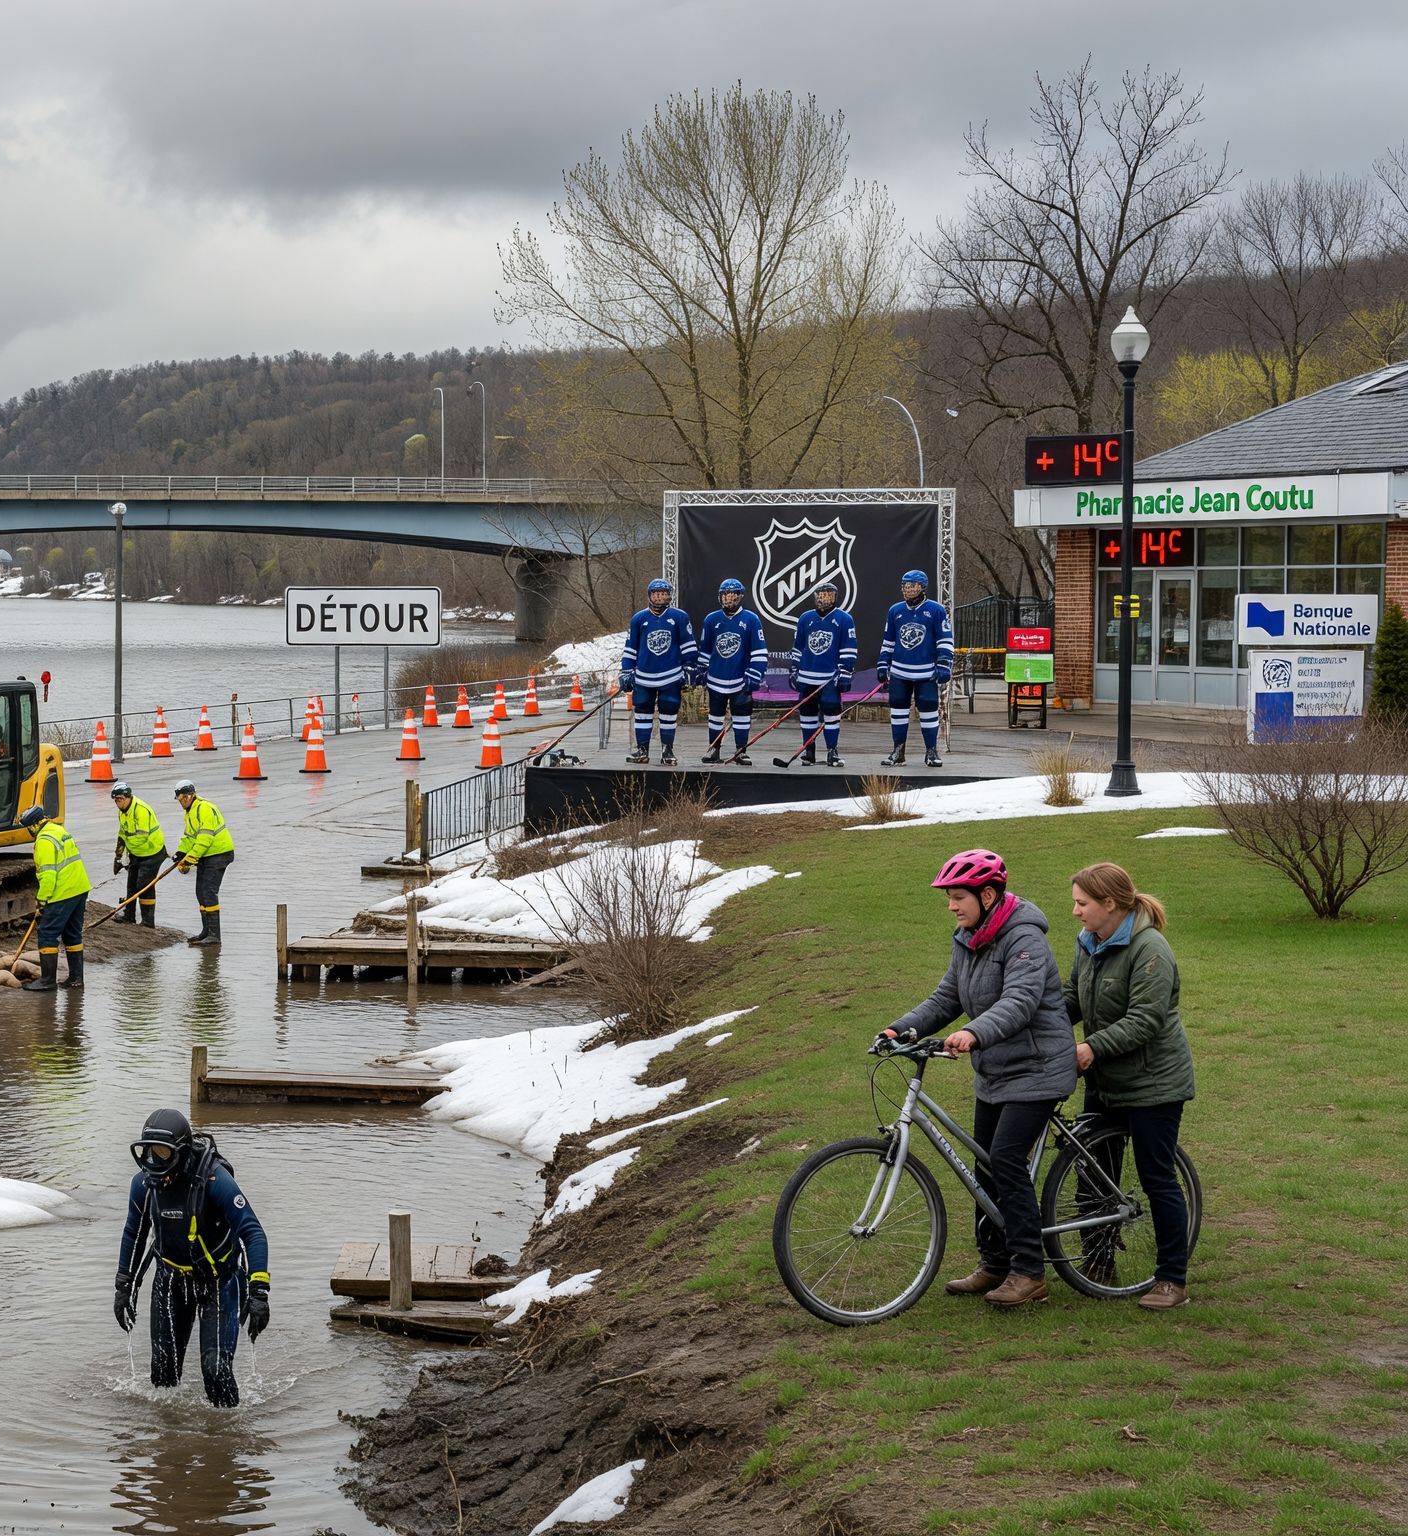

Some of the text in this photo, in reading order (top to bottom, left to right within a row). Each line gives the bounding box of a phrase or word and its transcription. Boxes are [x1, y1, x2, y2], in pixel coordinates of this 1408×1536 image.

[1189, 486, 1241, 513] Jean
[1245, 484, 1314, 512] Coutu
[777, 546, 836, 609] NHL
[296, 594, 429, 633] DÉTOUR
[1293, 603, 1353, 621] Banque
[1293, 621, 1371, 636] Nationale
